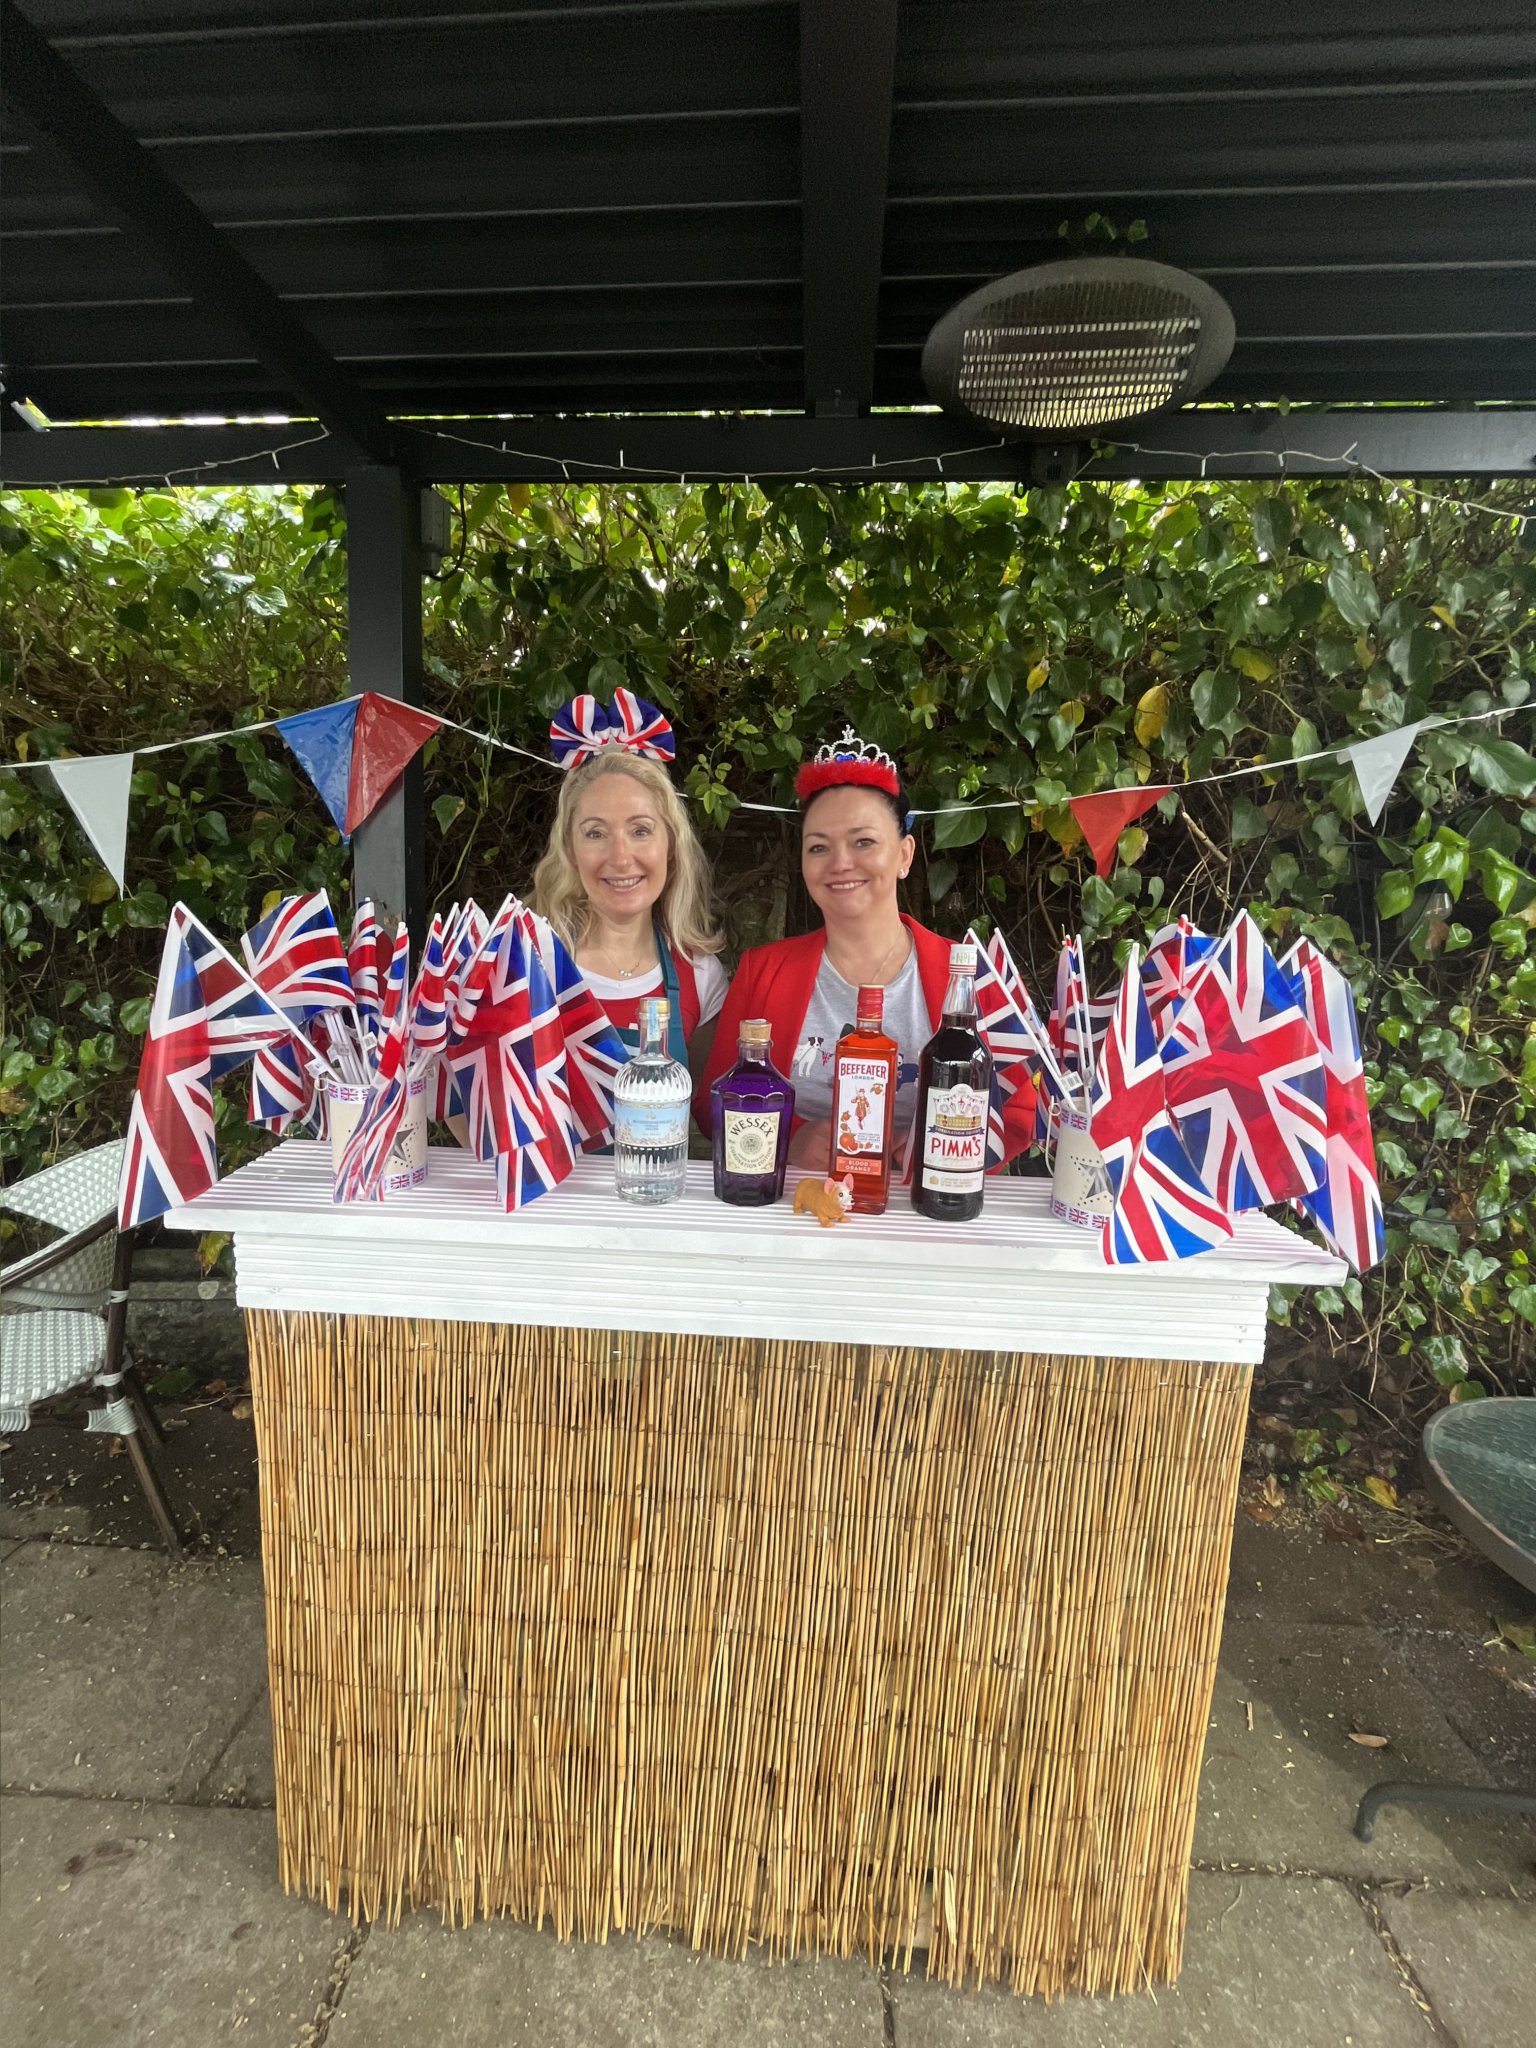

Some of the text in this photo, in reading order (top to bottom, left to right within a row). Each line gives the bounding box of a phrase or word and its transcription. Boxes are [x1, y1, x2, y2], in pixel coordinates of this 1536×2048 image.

[841, 1063, 886, 1080] BEEFEATER
[730, 1117, 773, 1138] WESSEX
[931, 1137, 981, 1157] PIMM'S
[730, 1145, 758, 1168] CORONATION
[758, 1147, 772, 1166] EDITION
[848, 1159, 869, 1167] BLOOD
[845, 1164, 871, 1172] ORANGE
